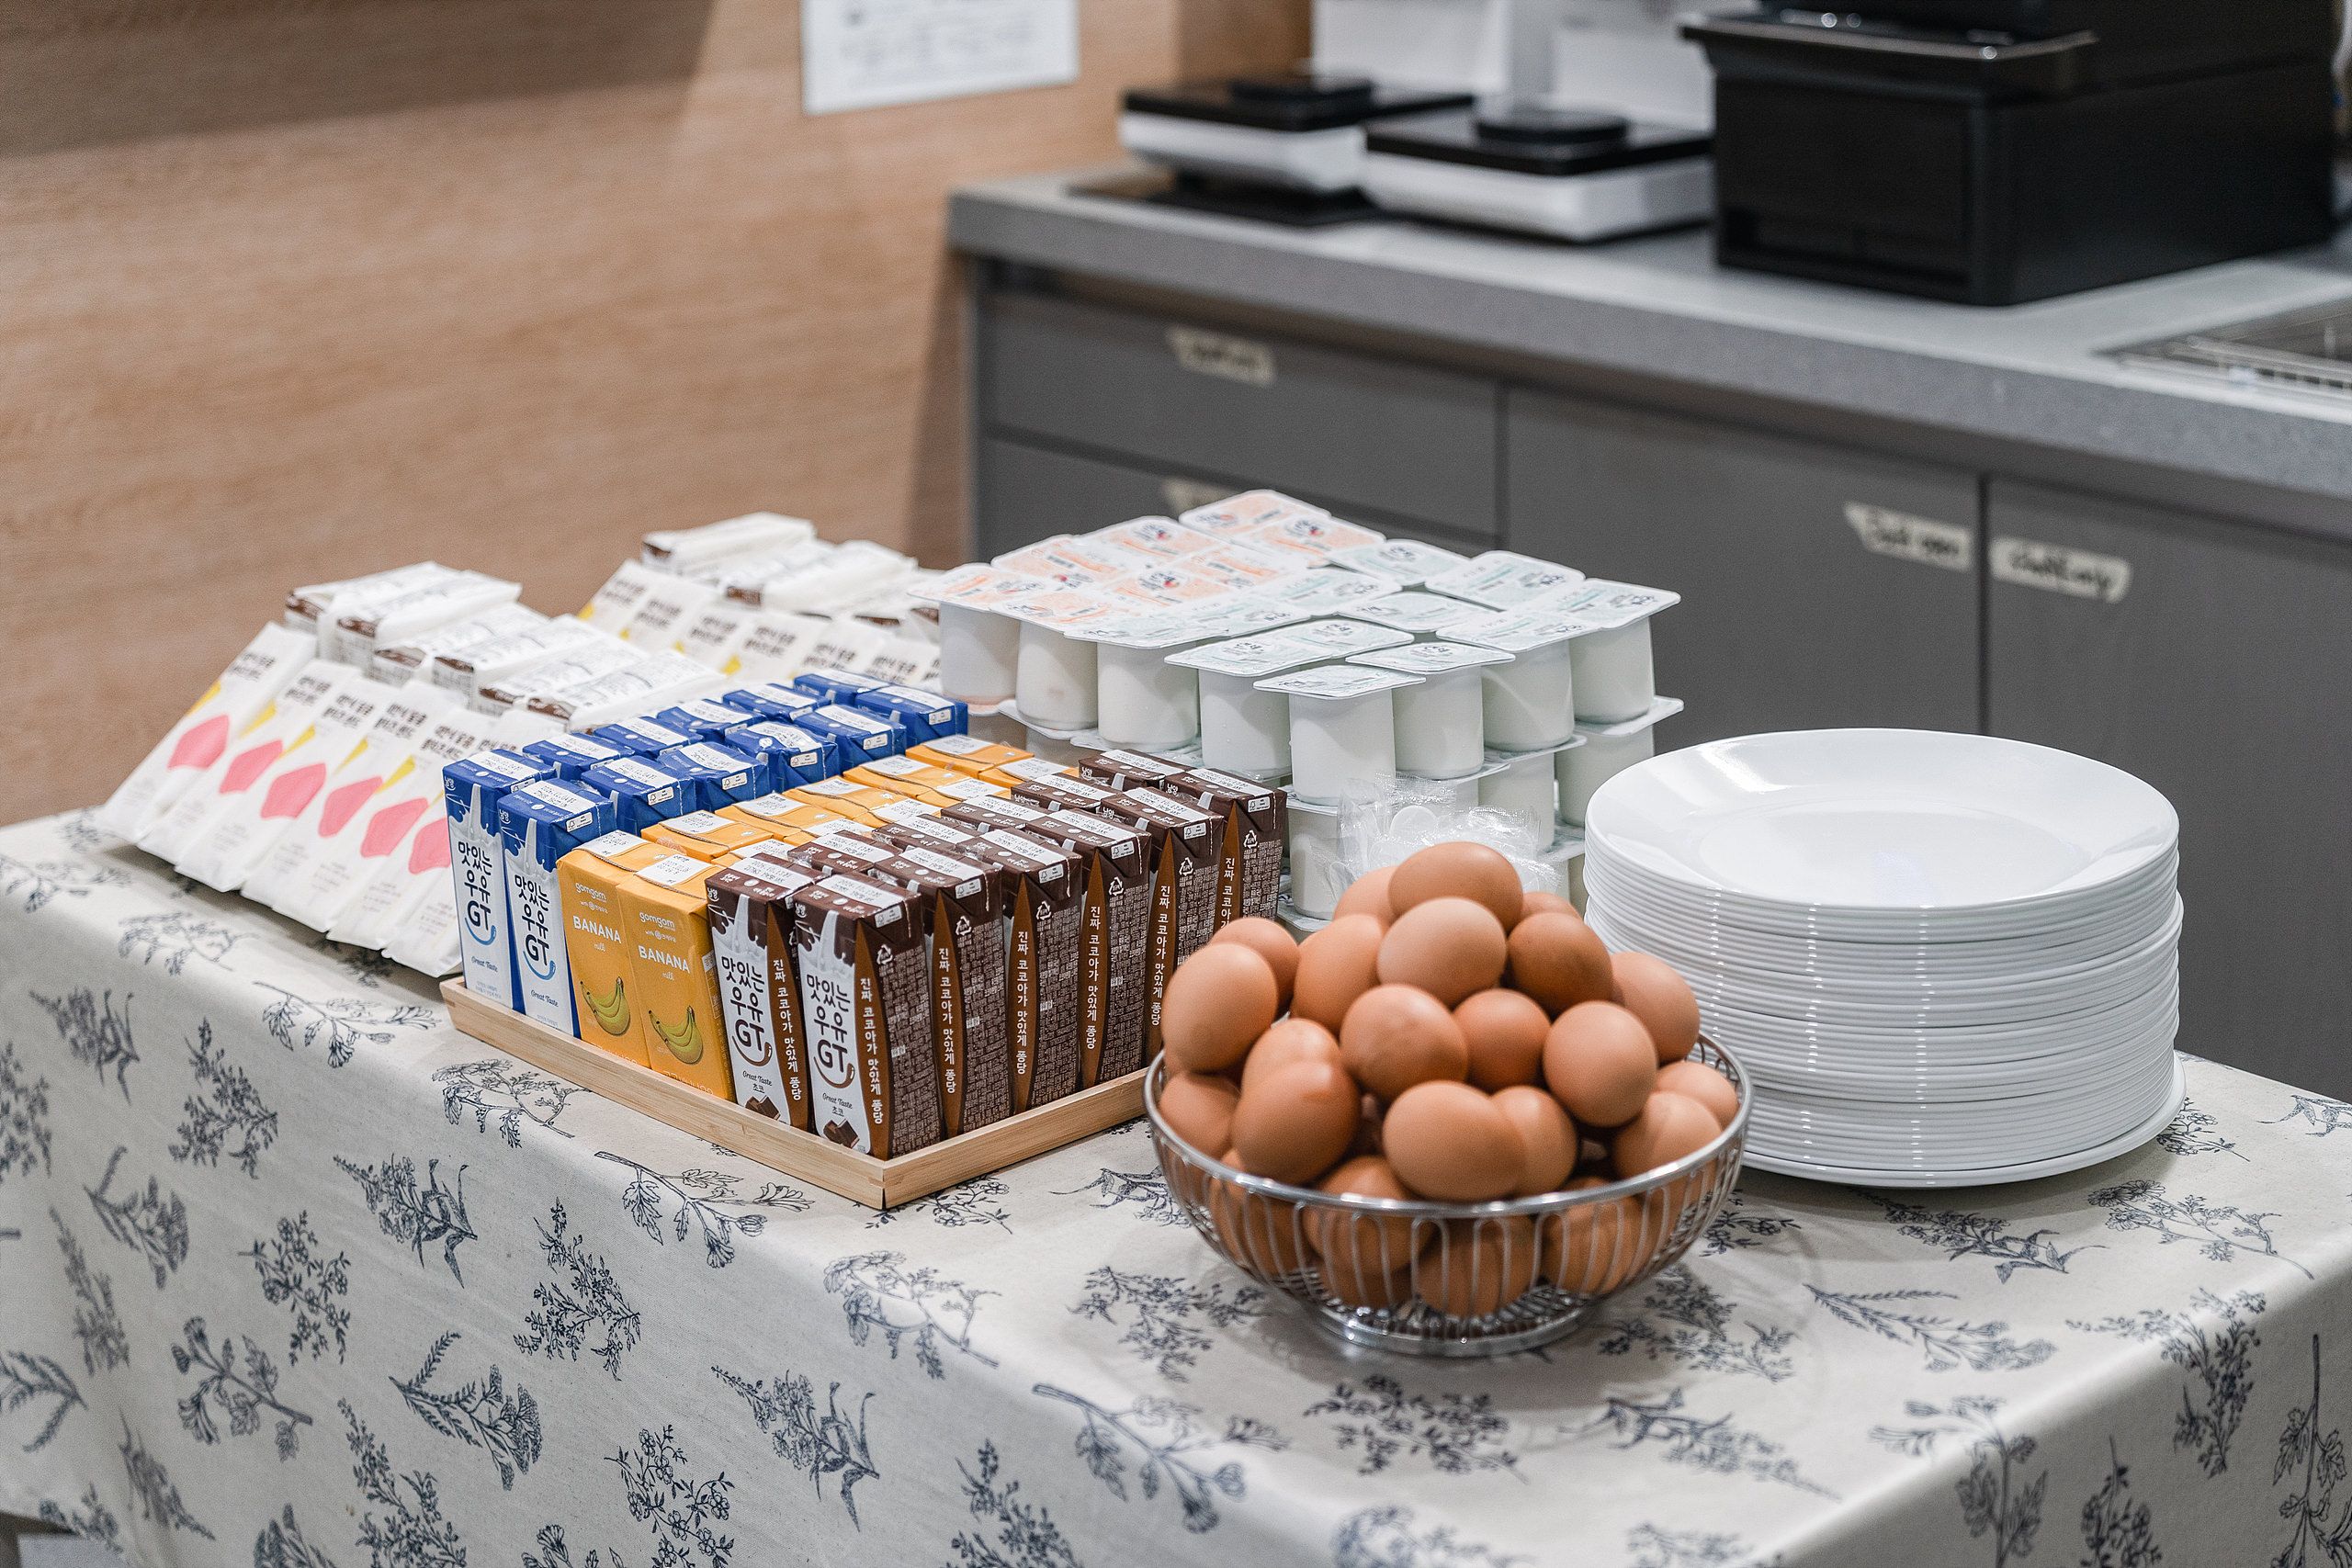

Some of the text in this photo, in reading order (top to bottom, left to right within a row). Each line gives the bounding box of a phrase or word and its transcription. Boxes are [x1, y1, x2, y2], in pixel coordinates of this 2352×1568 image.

[458, 841, 492, 875] 맛있는
[1224, 857, 1235, 881] 진짜
[464, 870, 492, 904] 우유
[514, 874, 550, 911] 맛있는
[1159, 886, 1170, 909] 진짜
[468, 900, 492, 931] GT
[521, 904, 549, 939] 우유
[572, 915, 622, 944] BANANA
[525, 934, 549, 965] GT
[1156, 913, 1169, 960] 코코아가
[638, 944, 690, 974] BANANA
[721, 955, 764, 993] 맛있는
[807, 974, 850, 1012] 맛있는
[1085, 906, 1101, 1049] 진짜 코코아가 맛있게 퐁당
[1153, 963, 1165, 998] 맛있게
[730, 987, 763, 1022] 우유
[1016, 931, 1029, 1075] 진짜 코코아가 맛있게 퐁당
[735, 1019, 764, 1052] GT
[773, 958, 802, 1100] 진짜 코코아가 맛있게 퐁당
[814, 1005, 847, 1043] 우유
[939, 948, 956, 1094] 진짜 코코아가 맛있게 퐁당
[817, 1039, 848, 1073] GT
[860, 977, 884, 1124] 진짜 코코아가 맛있게 퐁당
[742, 1070, 773, 1087] Great Taste
[822, 1092, 853, 1110] Great Taste
